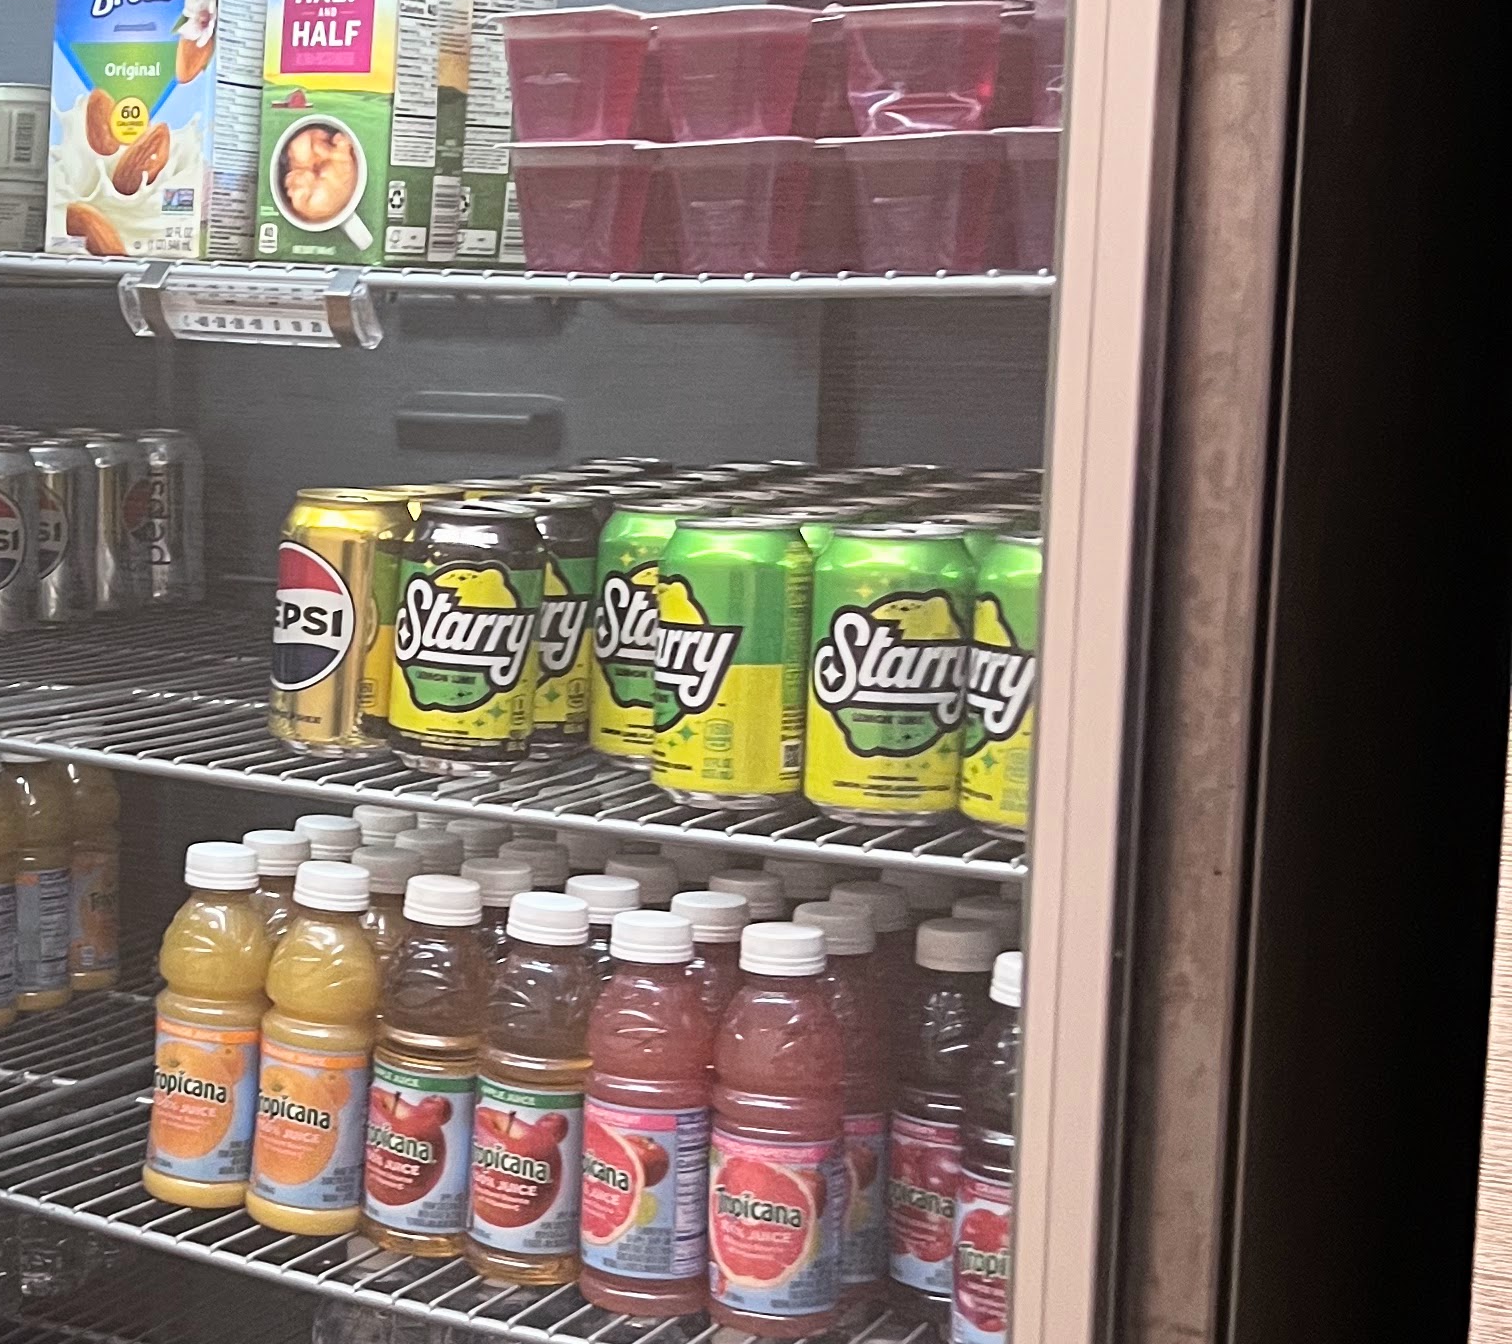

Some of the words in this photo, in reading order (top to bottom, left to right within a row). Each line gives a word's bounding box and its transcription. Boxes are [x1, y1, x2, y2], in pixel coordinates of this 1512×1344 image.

[317, 7, 338, 18] AND
[291, 20, 362, 47] HALF
[104, 61, 161, 80] Original
[121, 105, 141, 119] 60
[395, 579, 536, 687] Starry
[153, 1065, 227, 1104] ropicana
[259, 1088, 331, 1130] ropicana
